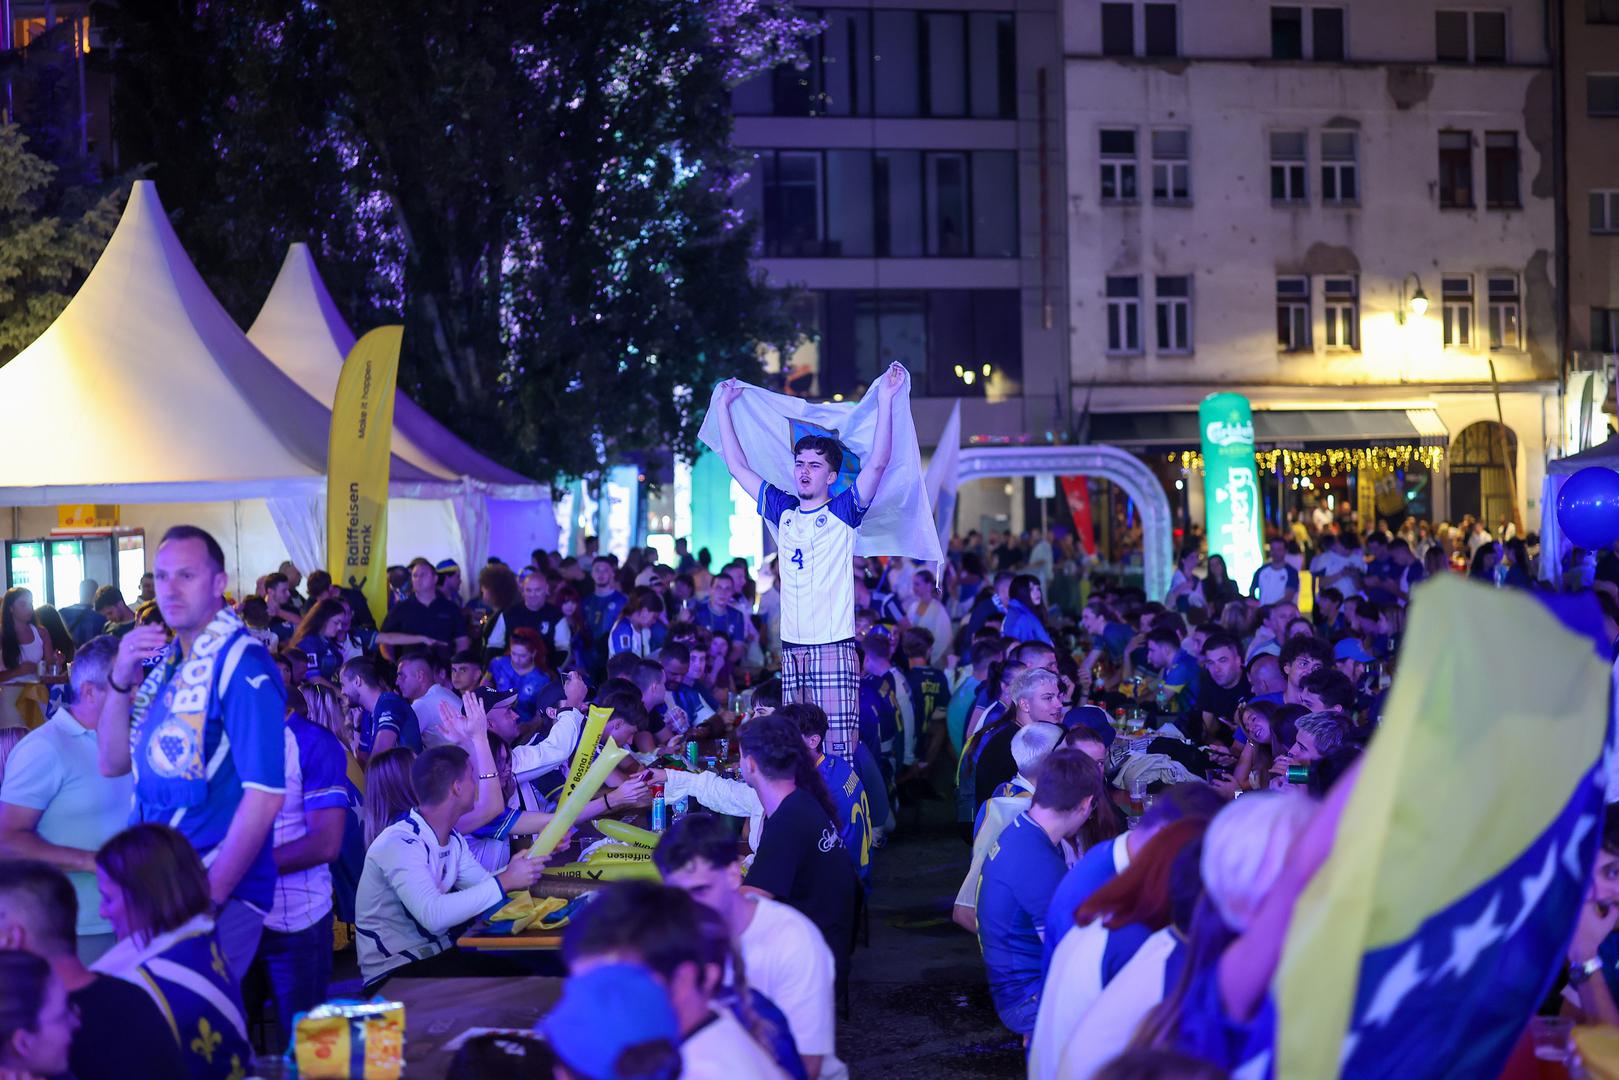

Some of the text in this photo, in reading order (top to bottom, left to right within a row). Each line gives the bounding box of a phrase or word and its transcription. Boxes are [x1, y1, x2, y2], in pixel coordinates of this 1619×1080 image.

[346, 481, 359, 567] Raiffeisen
[360, 524, 372, 567] Bank
[791, 548, 804, 570] 4
[171, 609, 244, 714] BOSN
[573, 757, 589, 783] Bosna
[607, 852, 651, 862] aiffeisen
